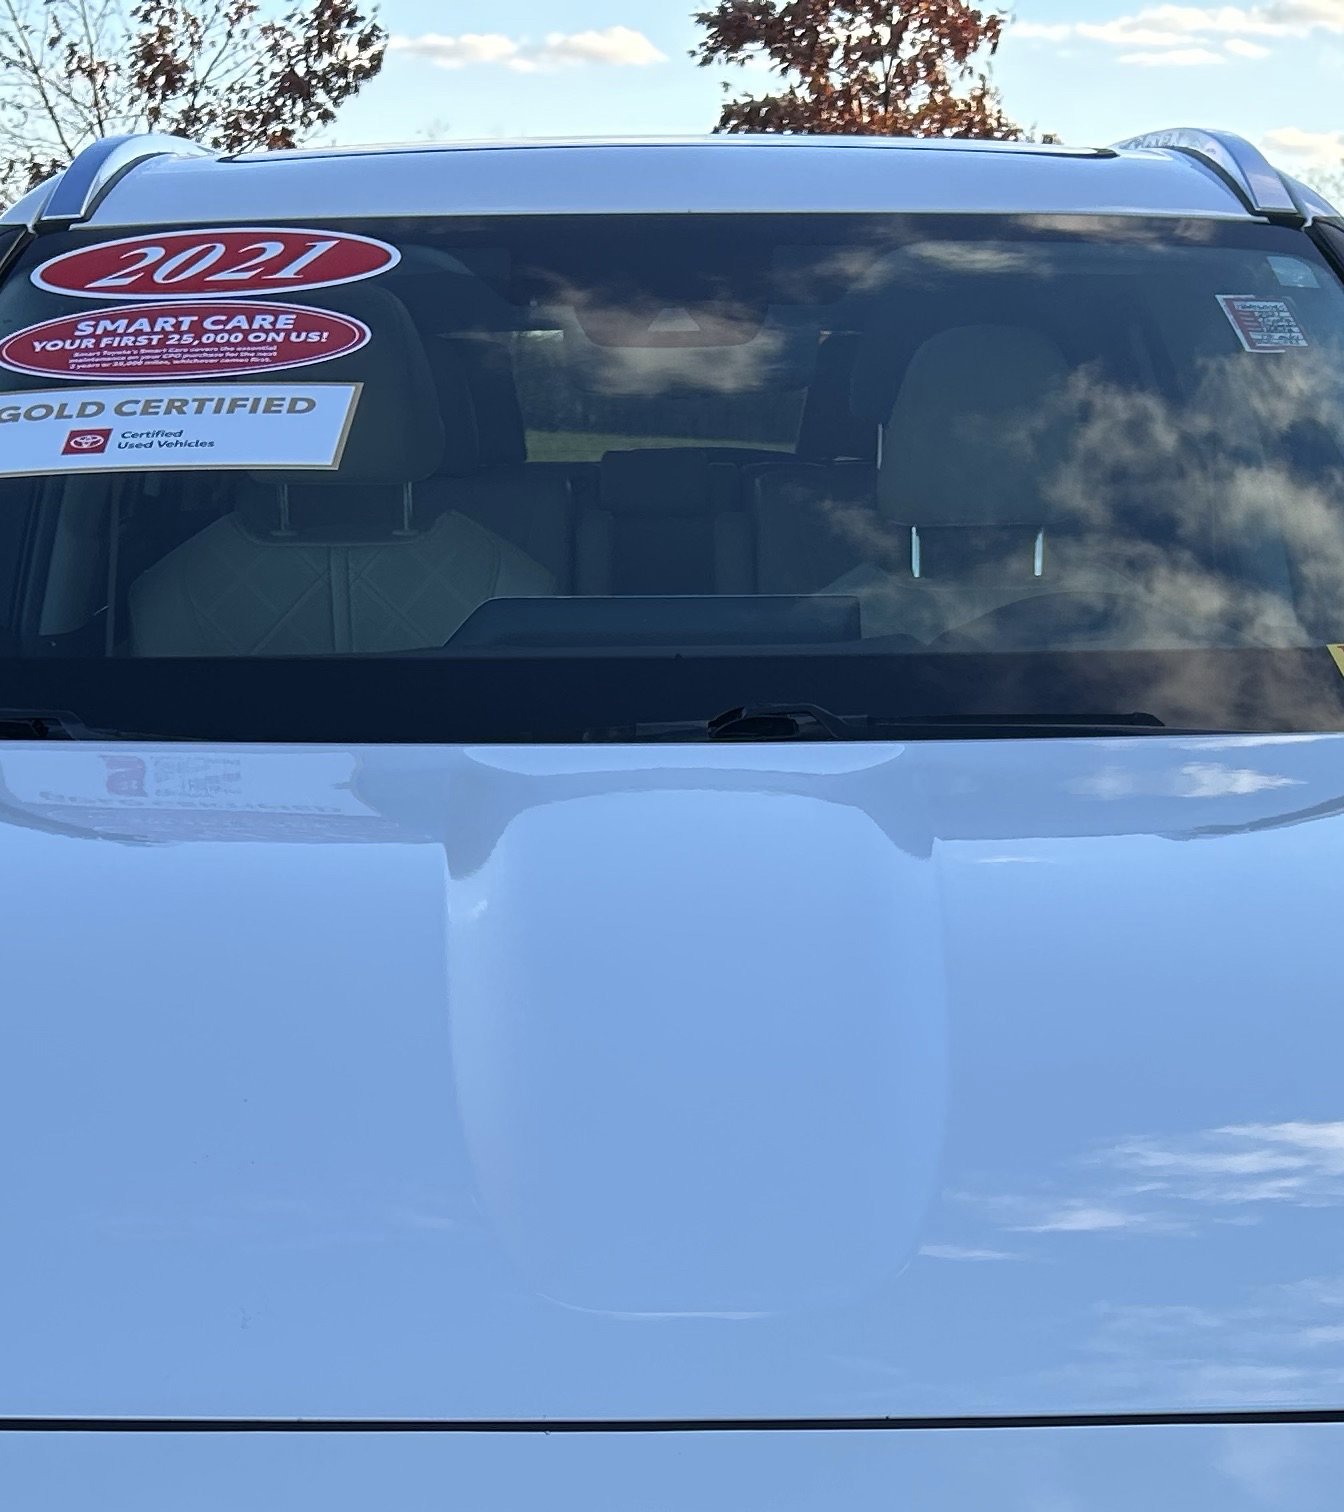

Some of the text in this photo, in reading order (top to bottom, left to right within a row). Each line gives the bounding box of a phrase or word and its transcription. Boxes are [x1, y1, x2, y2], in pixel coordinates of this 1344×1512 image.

[84, 239, 341, 288] 2021
[74, 314, 296, 335] SMART CARE
[33, 331, 330, 352] YOUR FIRST 25,000 ON US!
[114, 397, 316, 417] CERTIFIED
[117, 439, 215, 449] Used Vehicles
[121, 430, 184, 439] Certified
